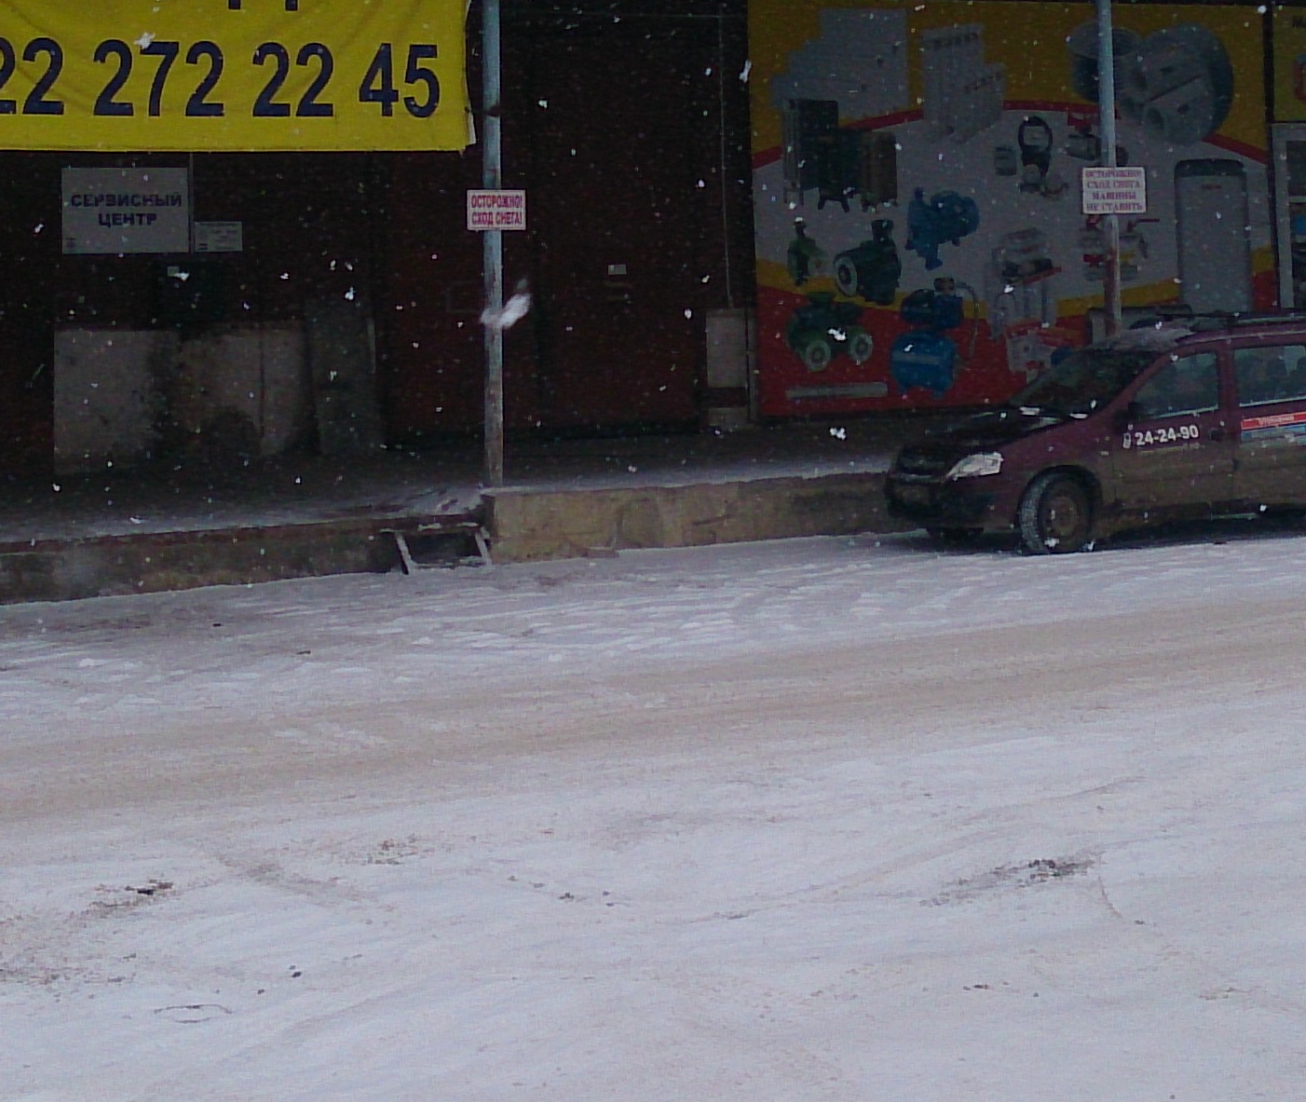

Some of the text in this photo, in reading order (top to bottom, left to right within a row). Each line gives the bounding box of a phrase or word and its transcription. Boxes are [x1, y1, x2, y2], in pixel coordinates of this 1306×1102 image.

[93, 39, 225, 117] 272
[253, 41, 334, 117] 22
[359, 42, 440, 118] 45
[71, 191, 182, 207] СЕРВИСНЫЙ
[98, 213, 157, 227] ЦЕНТР
[1134, 424, 1200, 446] 24-24-90
